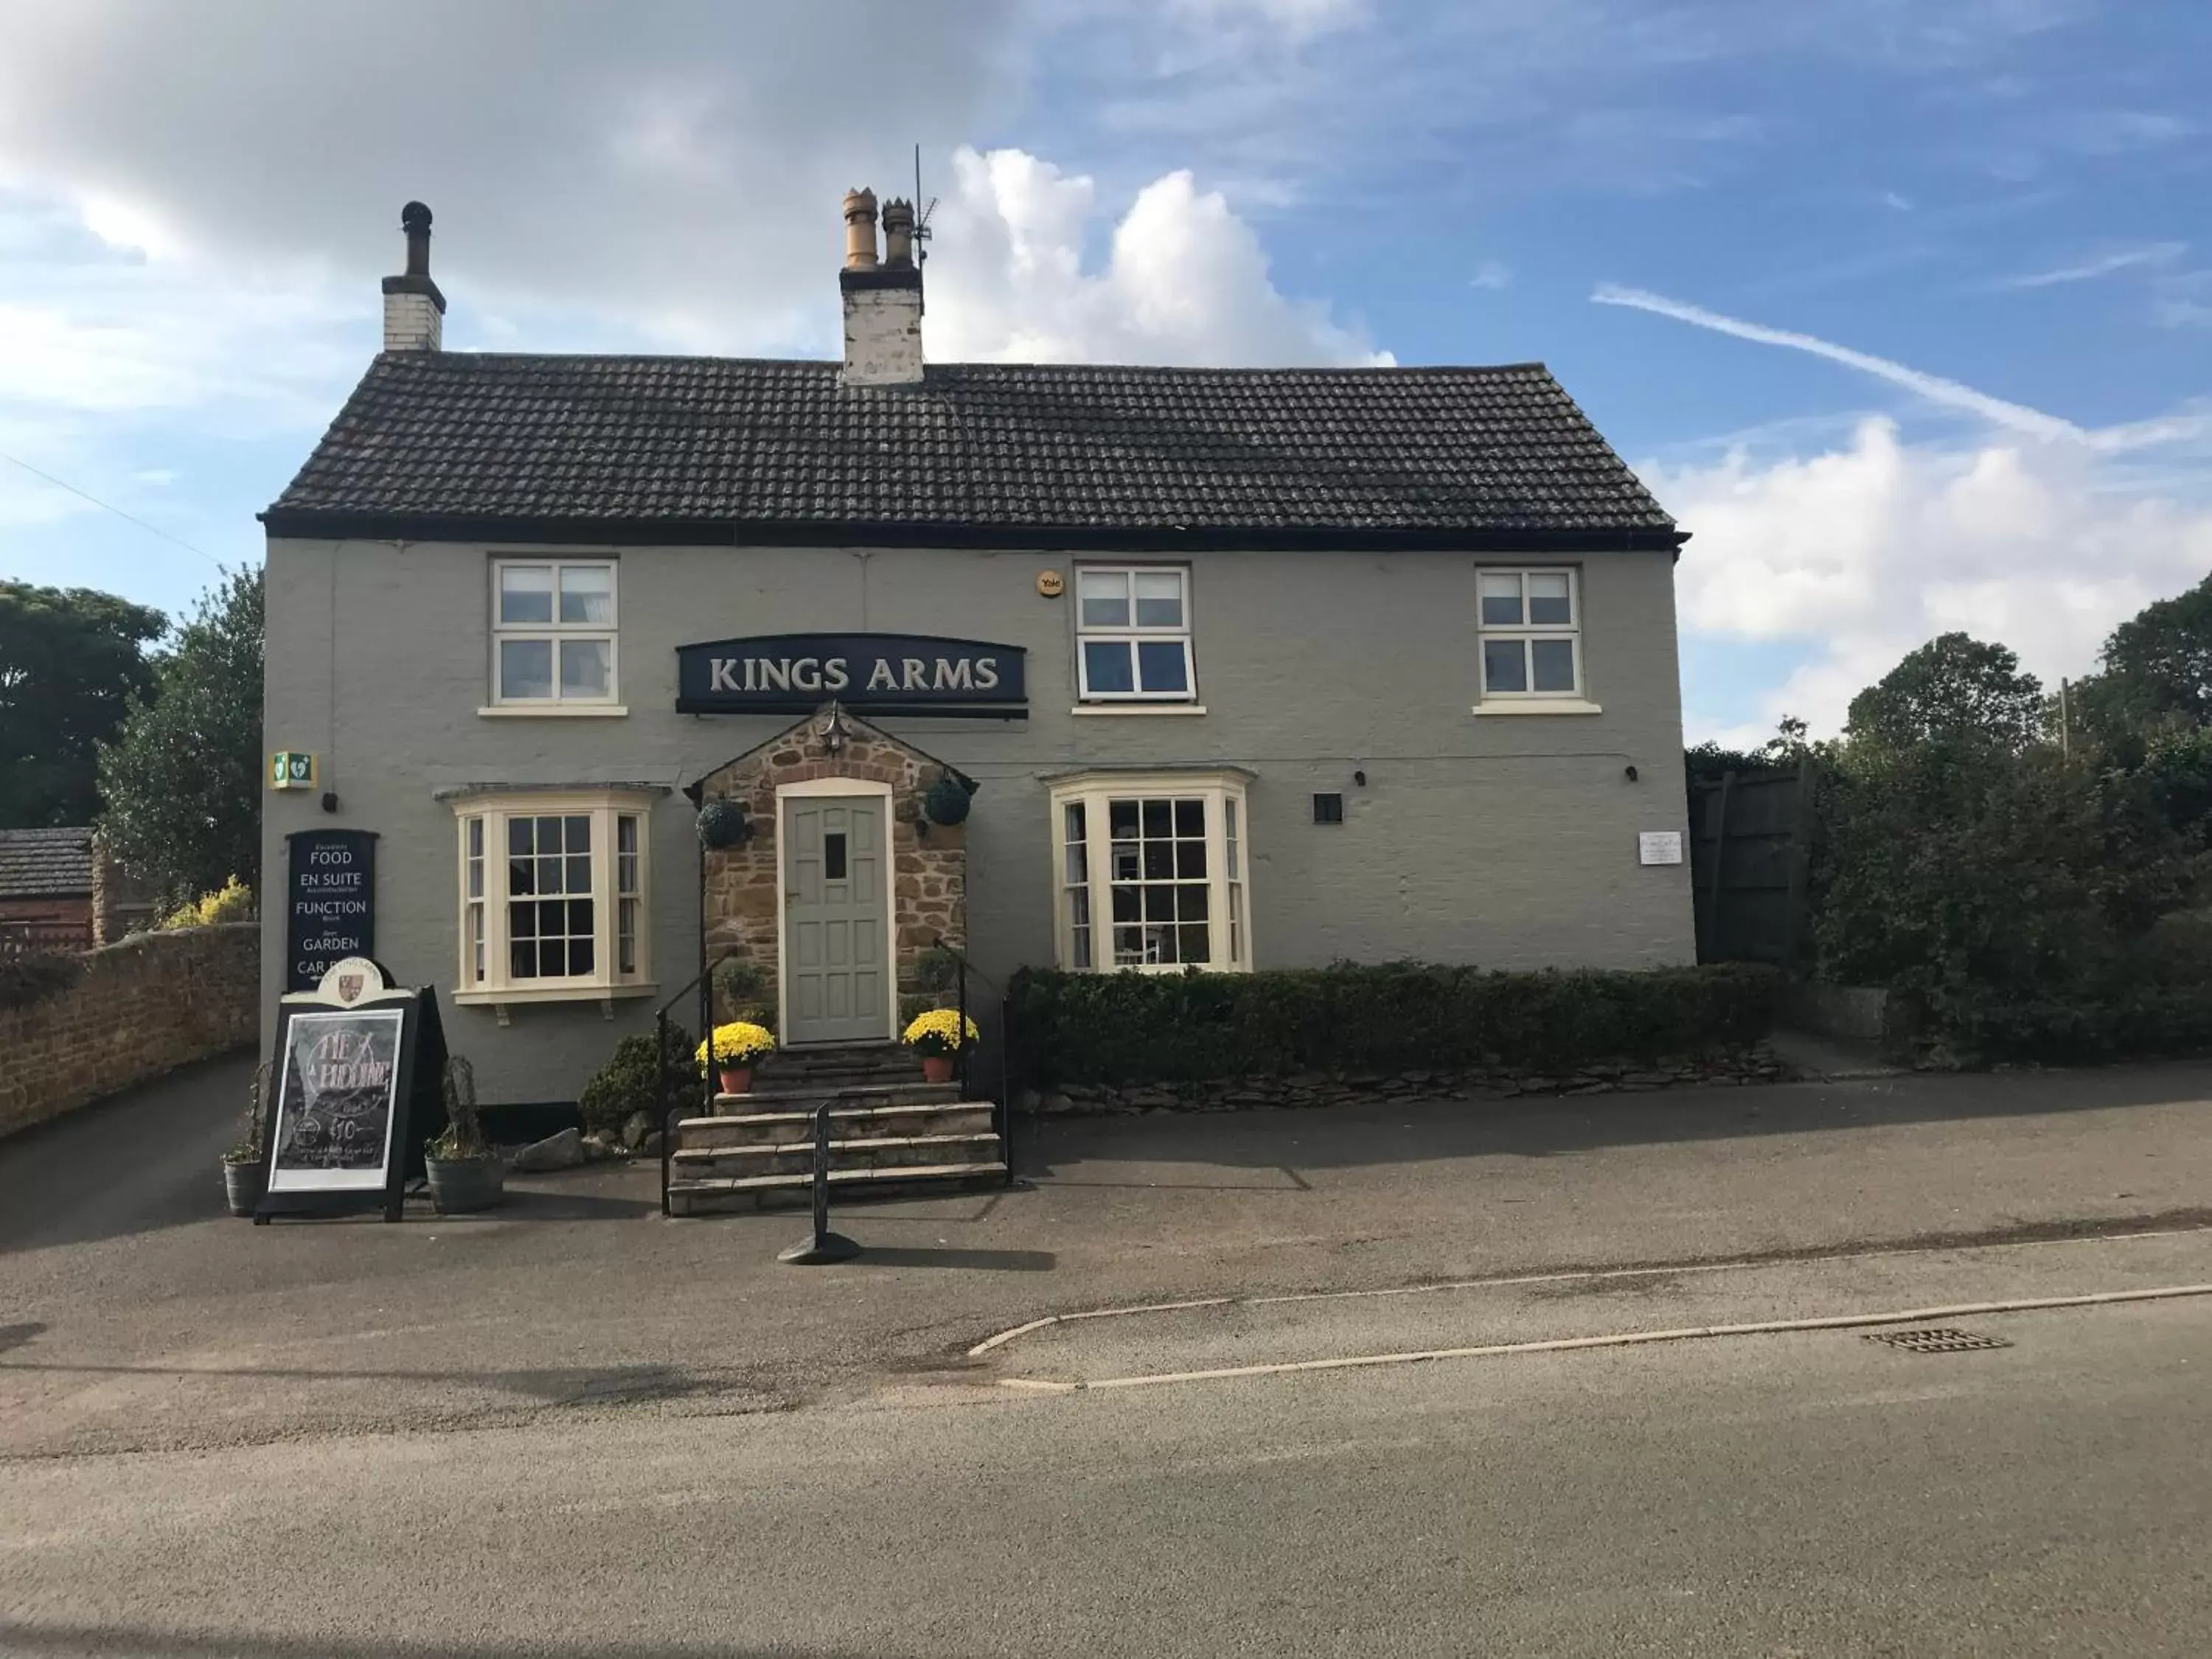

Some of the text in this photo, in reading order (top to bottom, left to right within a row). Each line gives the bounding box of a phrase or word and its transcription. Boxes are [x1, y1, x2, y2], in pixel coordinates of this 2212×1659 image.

[709, 658, 999, 692] KINGS ARMS
[310, 852, 352, 865] FOOD
[300, 872, 362, 886] EN SUITE
[296, 900, 366, 915] FUNCTION
[303, 936, 359, 951] GARDEN
[297, 960, 324, 974] CAR
